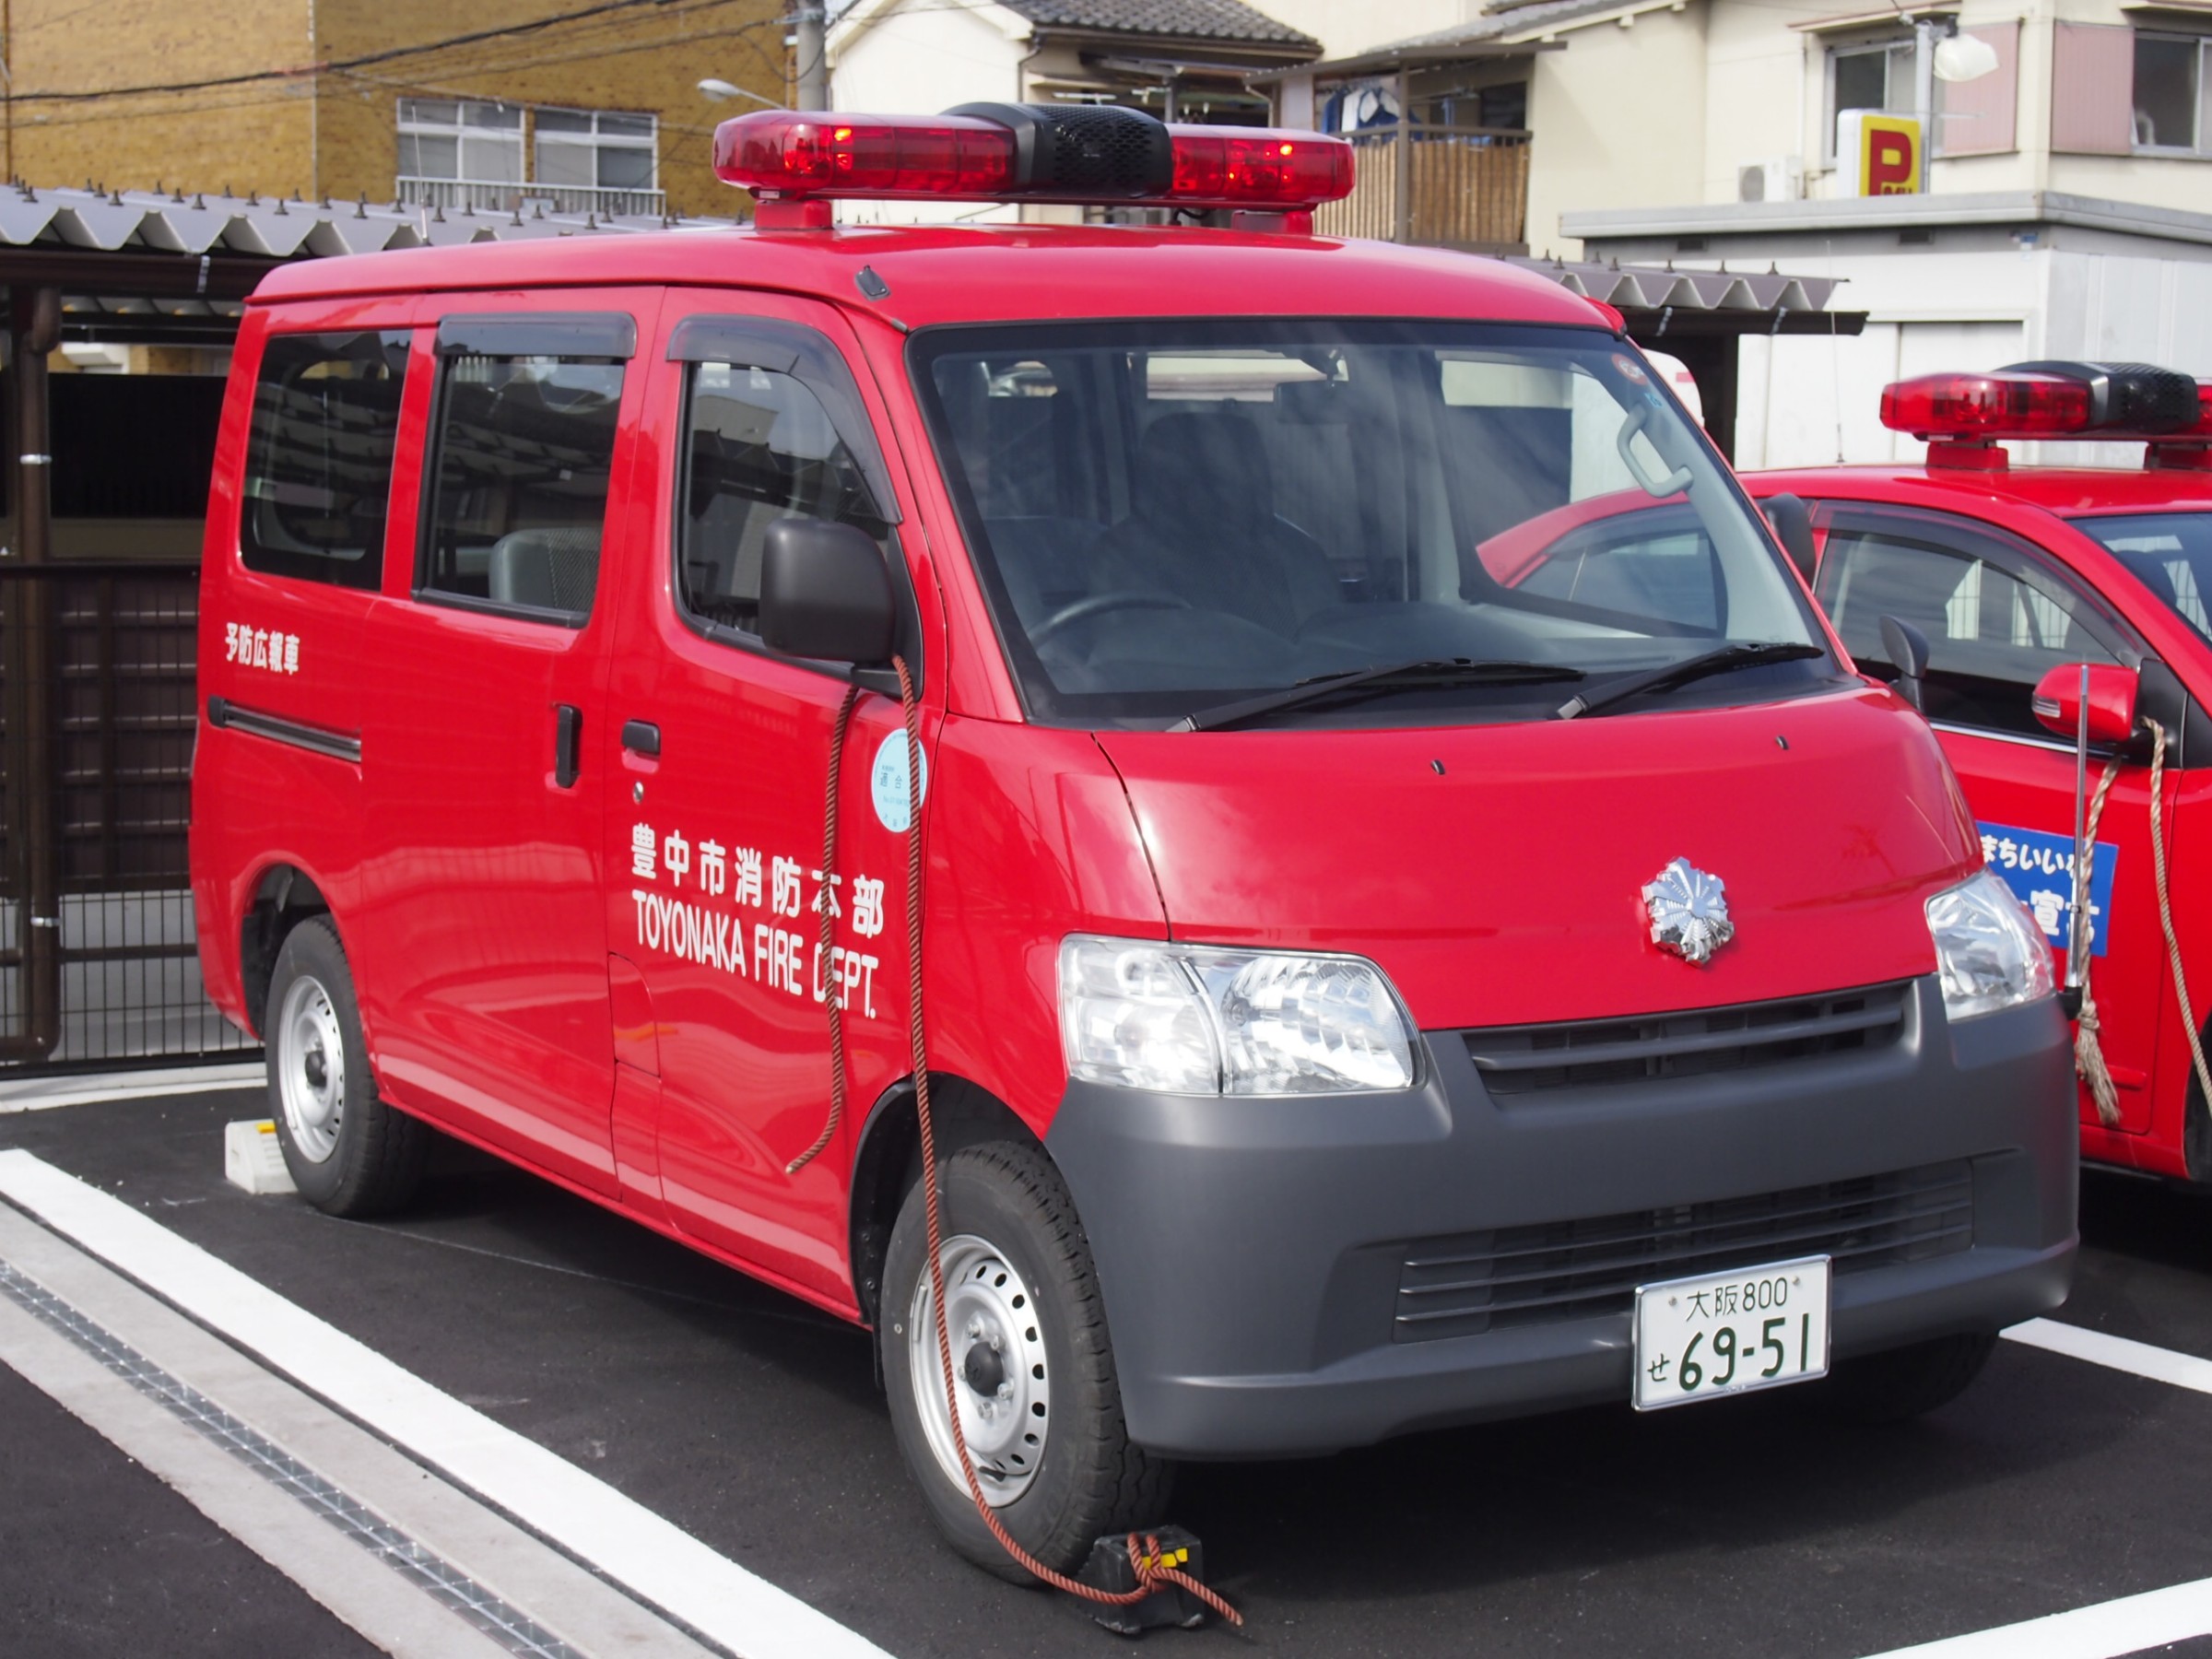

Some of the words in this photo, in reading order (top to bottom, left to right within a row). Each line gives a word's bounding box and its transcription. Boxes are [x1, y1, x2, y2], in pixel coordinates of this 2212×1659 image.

[1868, 129, 1912, 195] P
[225, 622, 300, 676] 予防広報車
[631, 822, 885, 939] 豊中市消防本部
[631, 888, 747, 978] TOYONAKA
[754, 923, 804, 996] FIRE
